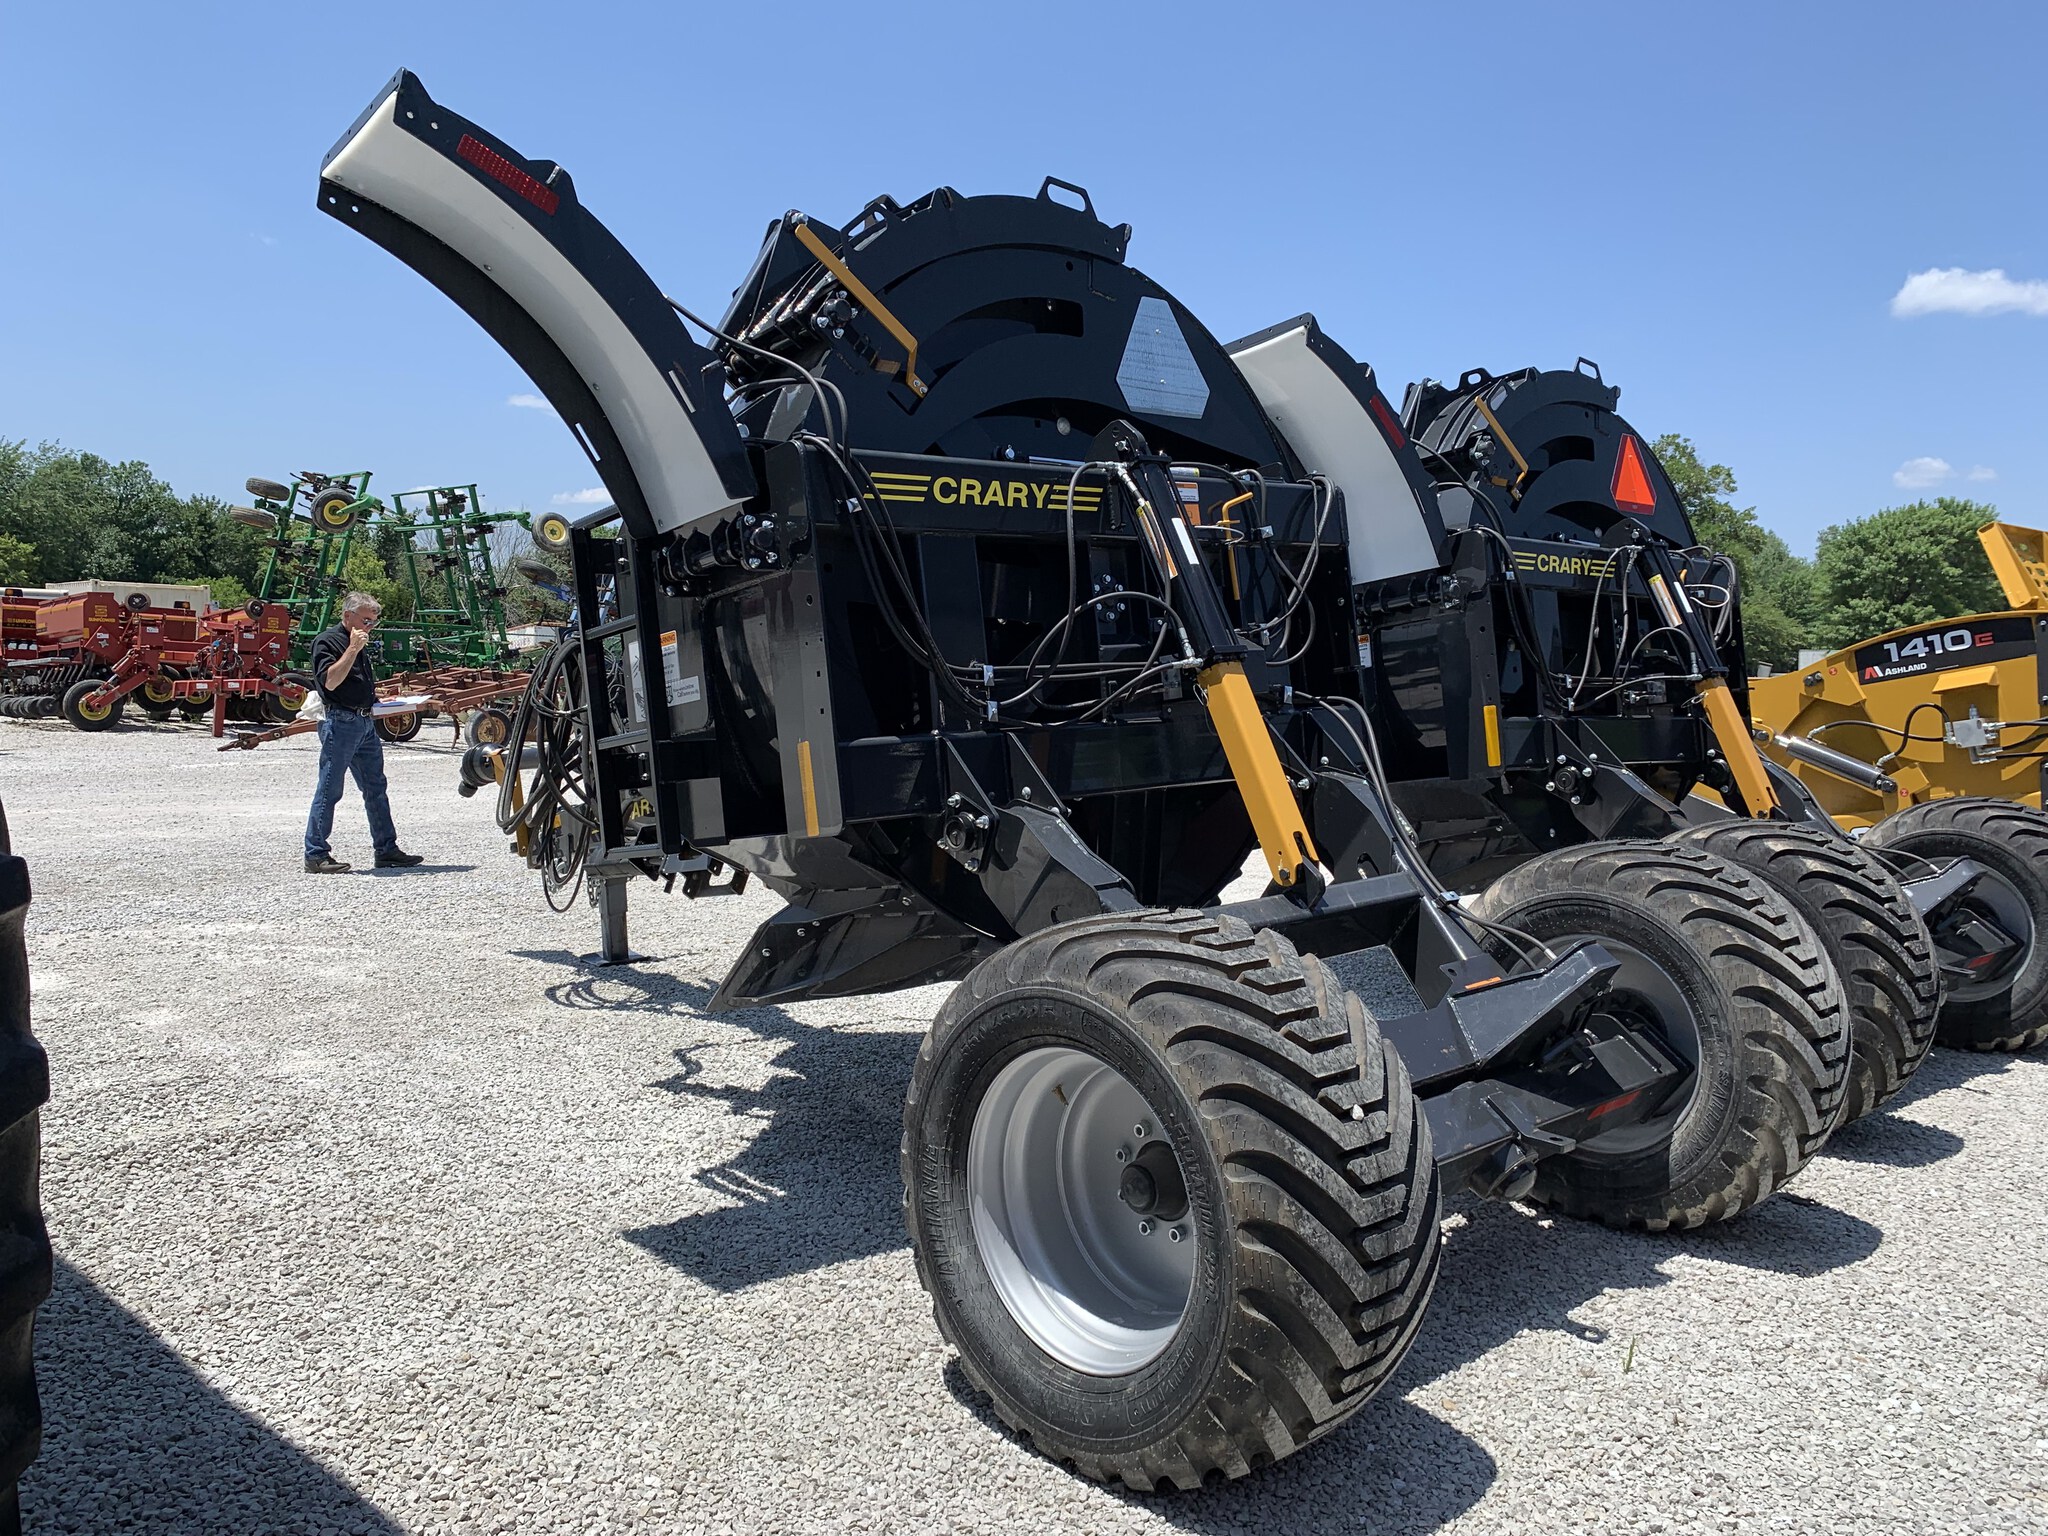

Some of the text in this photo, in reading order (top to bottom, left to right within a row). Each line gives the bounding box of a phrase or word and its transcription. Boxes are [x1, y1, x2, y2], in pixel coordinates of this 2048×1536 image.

[933, 476, 1050, 509] CRARY
[1537, 554, 1591, 576] CRARY
[1883, 629, 1972, 662] 1410
[1885, 662, 1927, 676] ASHLAND
[1671, 1081, 1728, 1172] ALLIANCE
[922, 1144, 955, 1275] ALLIANCE
